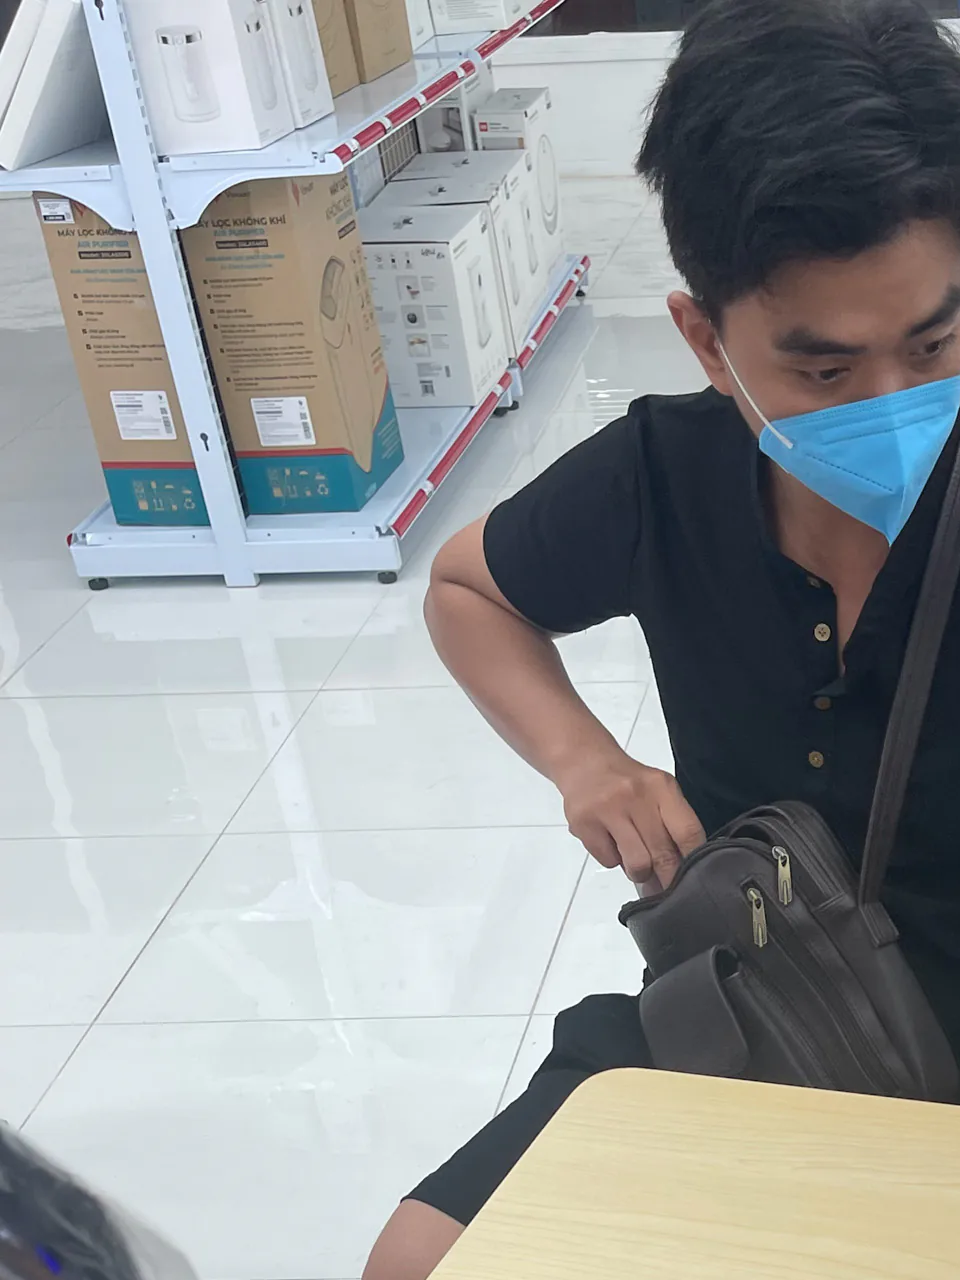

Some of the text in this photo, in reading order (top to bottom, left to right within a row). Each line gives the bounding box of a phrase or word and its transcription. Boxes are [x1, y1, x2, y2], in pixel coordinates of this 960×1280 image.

[211, 218, 231, 229] LỌC
[233, 216, 267, 227] KHÔNG
[269, 214, 286, 225] KHÍ
[57, 228, 75, 237] MÁY
[78, 229, 95, 238] LỌC
